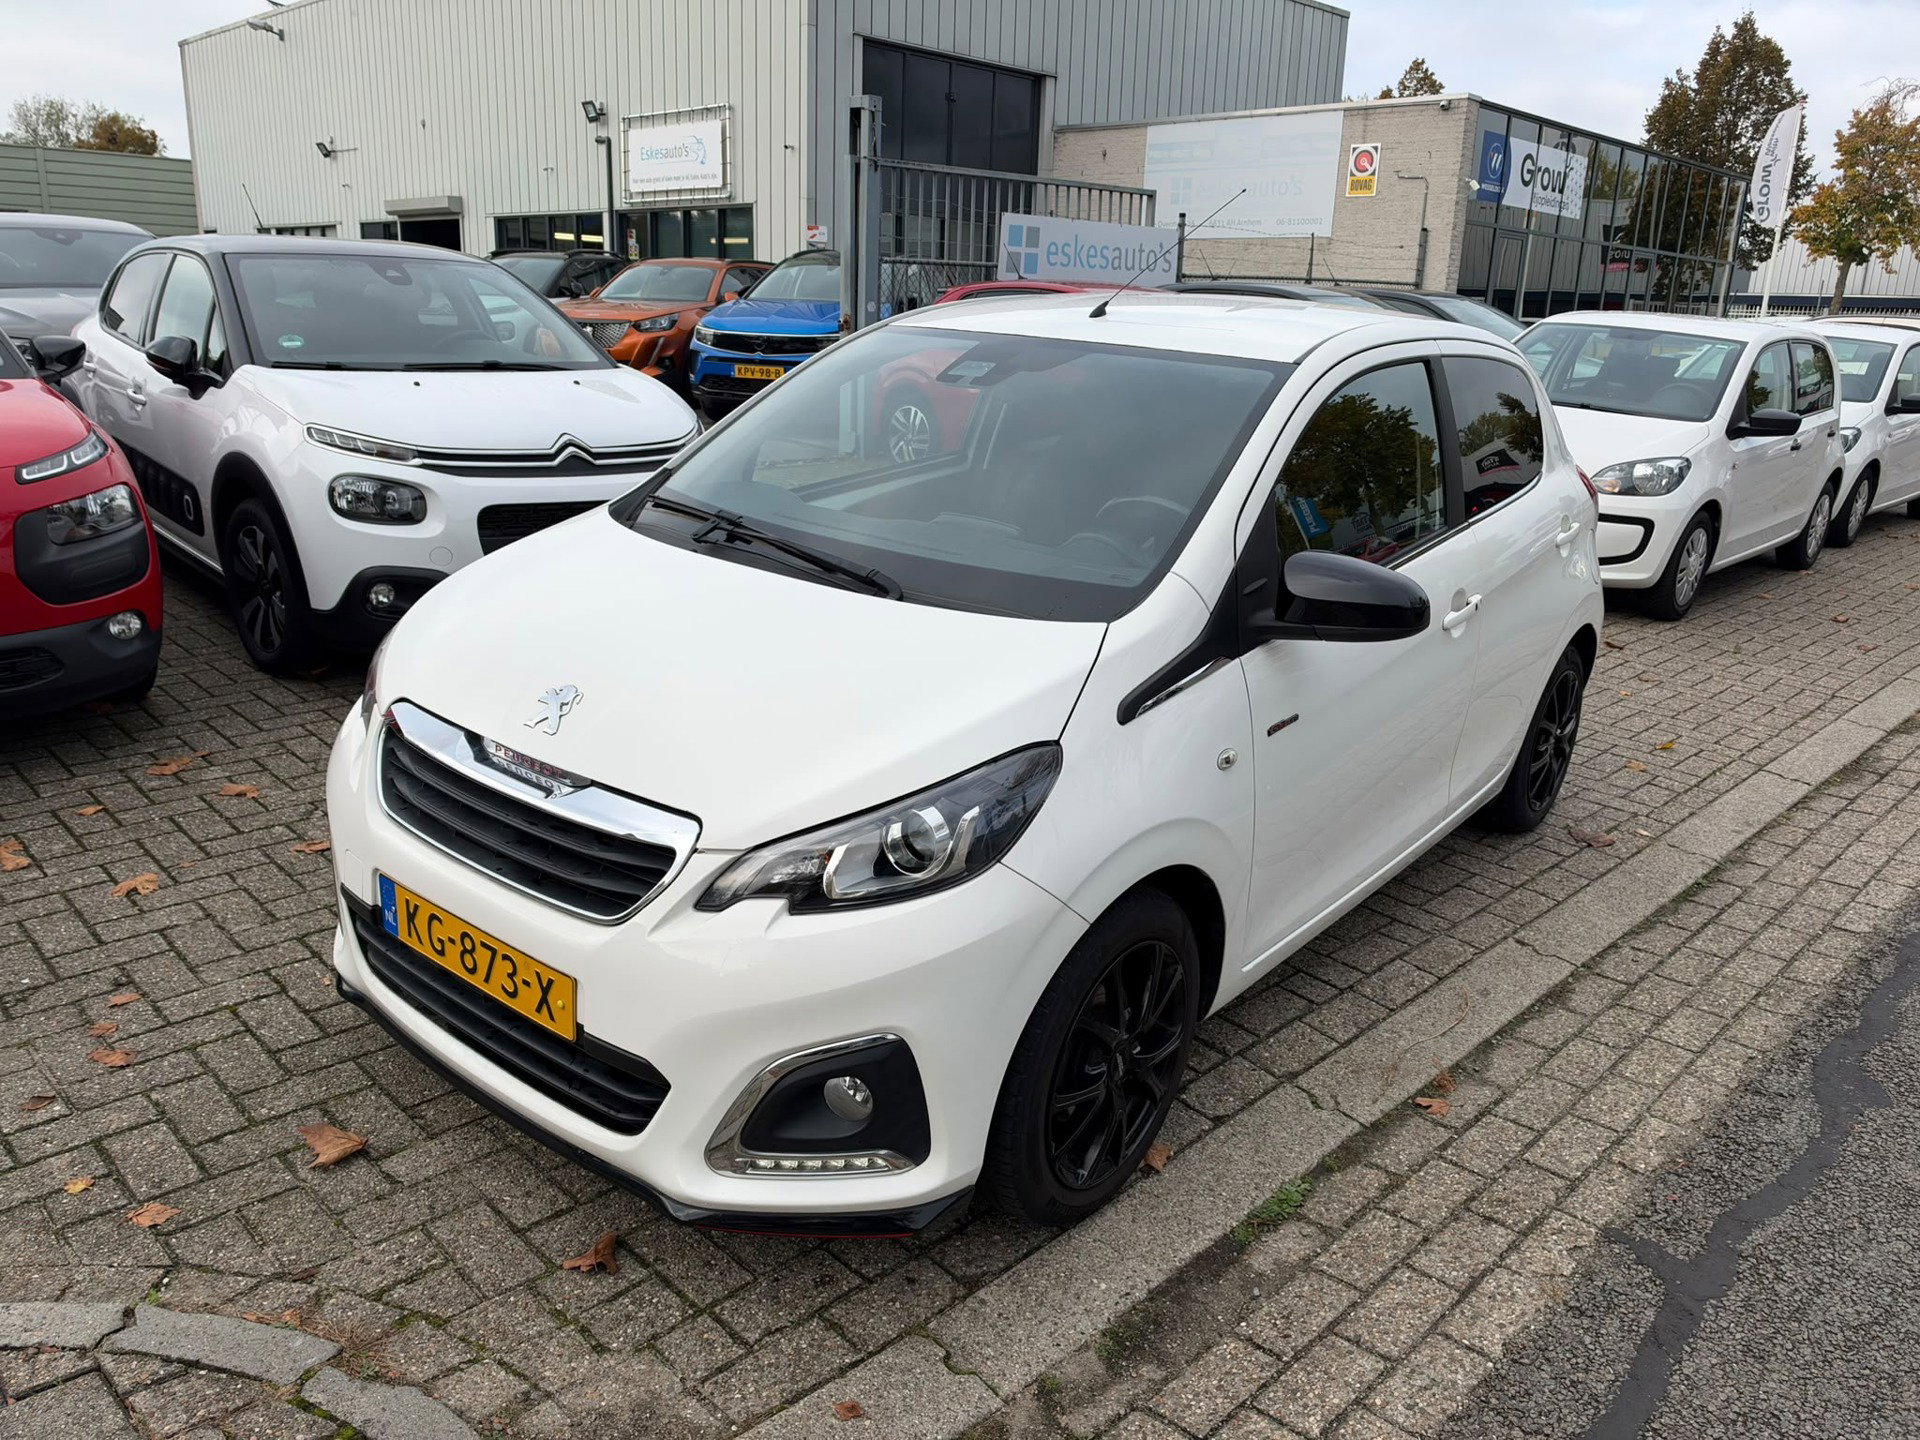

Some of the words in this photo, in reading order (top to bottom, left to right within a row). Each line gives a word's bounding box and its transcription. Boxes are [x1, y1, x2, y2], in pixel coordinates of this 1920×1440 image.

[1350, 178, 1373, 191] BOVAG
[1521, 153, 1567, 195] Grow
[1046, 234, 1172, 273] eskesauto's
[737, 366, 781, 379] KPV-98-B
[494, 744, 564, 780] PEUGEOT
[385, 910, 397, 927] NL
[405, 897, 556, 1023] KG-873-X
